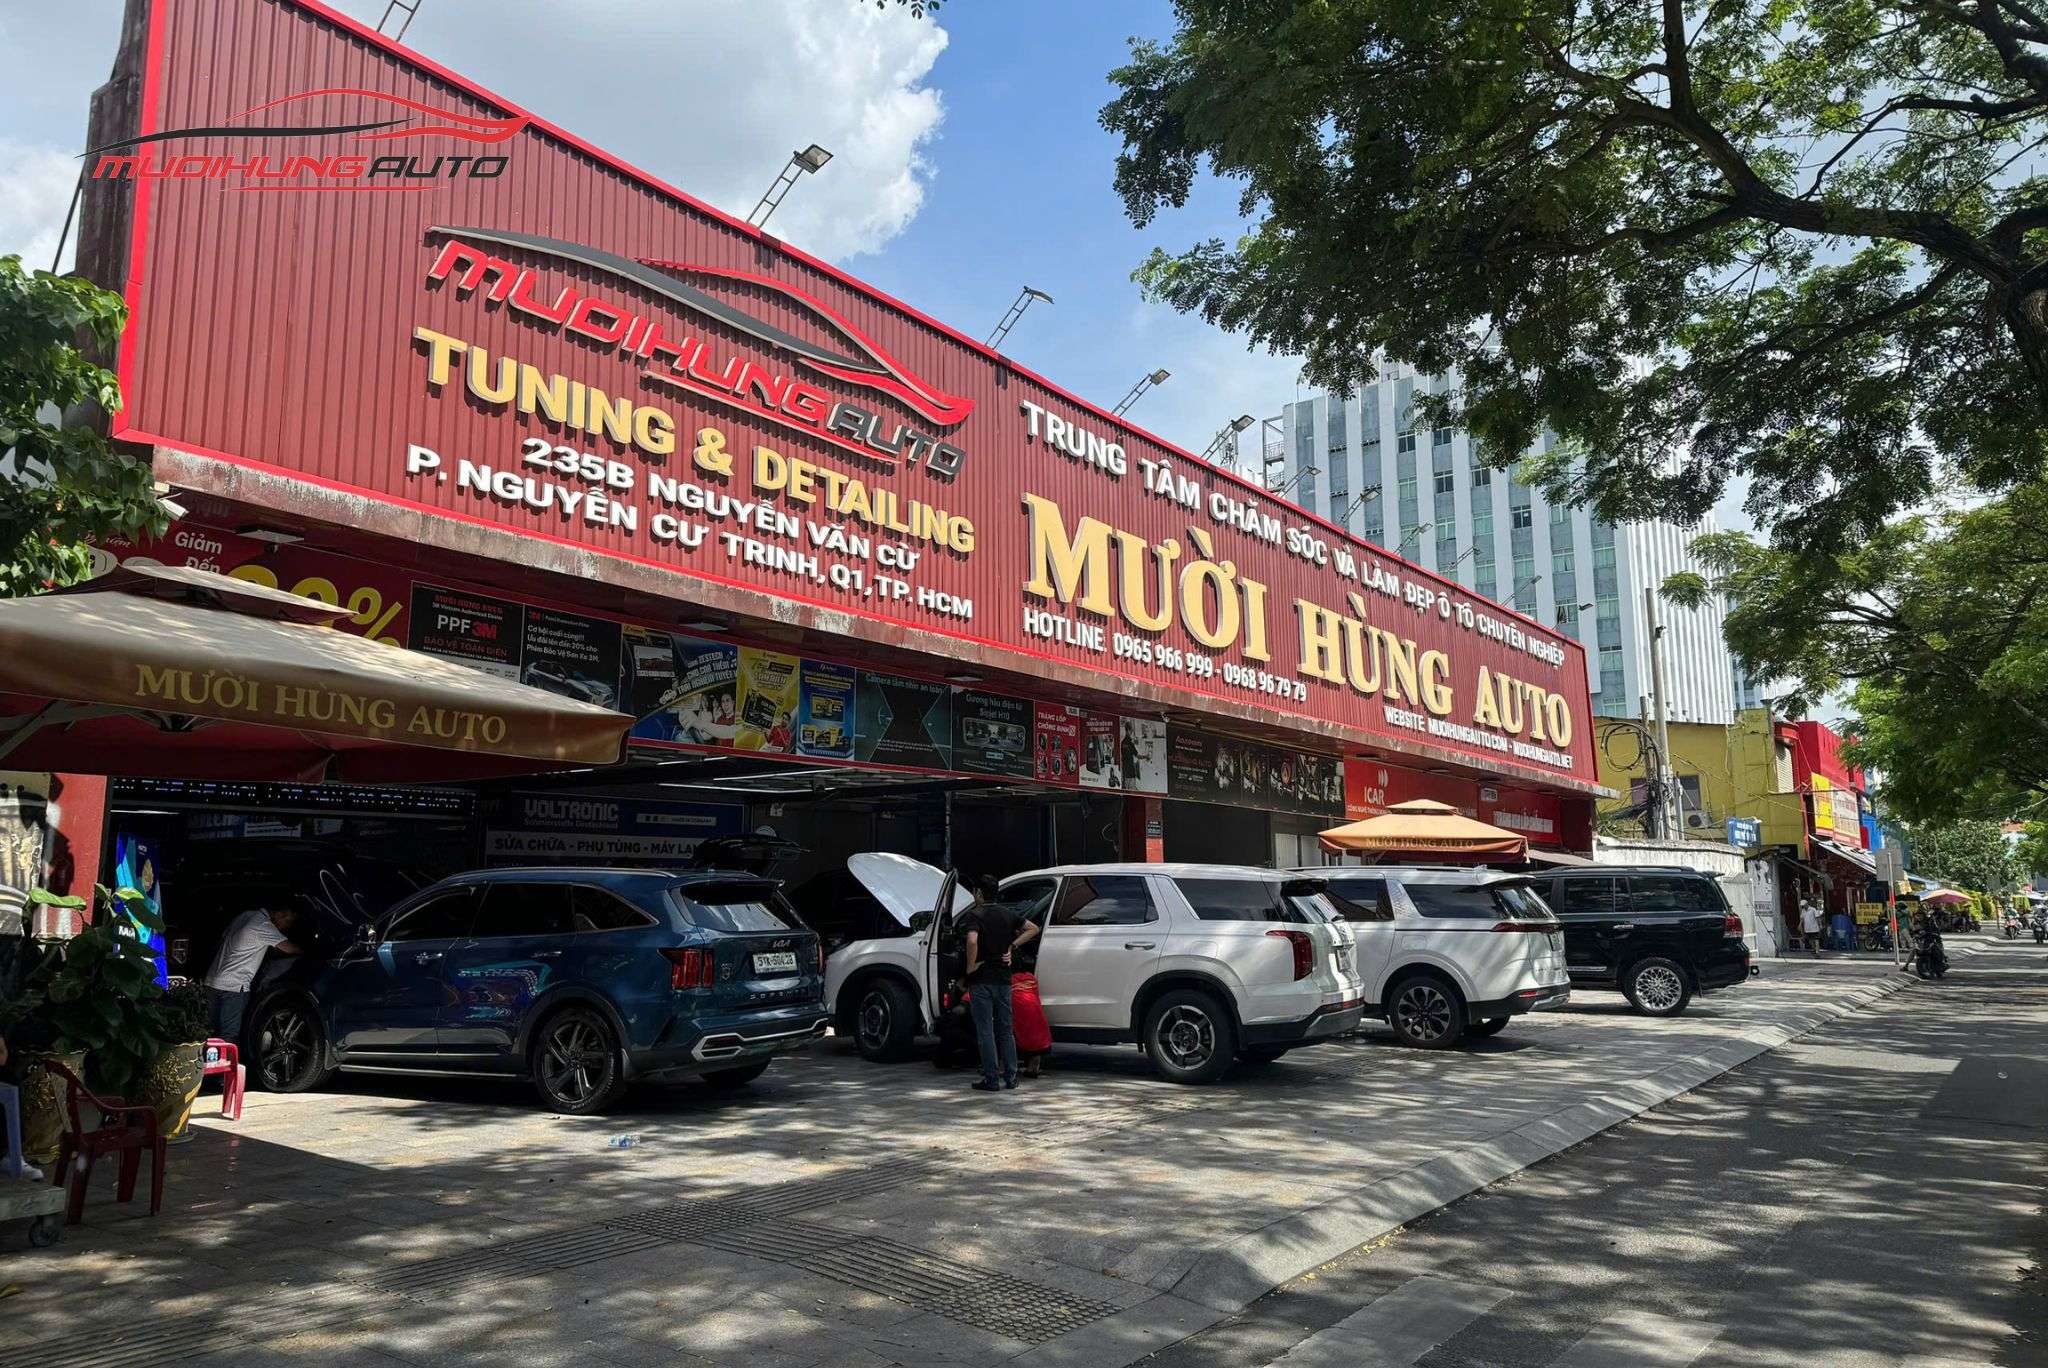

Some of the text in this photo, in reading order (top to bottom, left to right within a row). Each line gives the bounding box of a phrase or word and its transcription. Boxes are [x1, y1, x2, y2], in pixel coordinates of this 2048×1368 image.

[414, 327, 976, 553] TUNING & DETAILING
[407, 443, 447, 481] P.
[457, 459, 637, 531] NGUYỄN
[651, 513, 710, 547] CƯ
[917, 585, 974, 618] HCM
[523, 438, 920, 571] 235B NGUYỄN VĂN CỪ
[175, 531, 223, 555] Giảm
[1022, 400, 1565, 669] TRUNG TÂM CHĂM SÓC VÀ LÀM ĐẸP Ô TÔ CHUYÊN NGHIỆP
[437, 614, 497, 641] PPF 3M
[1021, 491, 1572, 748] MƯỜI HÙNG AUTO
[1113, 632, 1152, 663] 0965
[1155, 644, 1182, 672] 966
[1186, 652, 1213, 678] 999
[1223, 662, 1256, 689] 0968
[135, 664, 507, 744] MƯỜI HÙNG AUTO
[524, 799, 619, 822] VOLTRONIC
[1364, 785, 1385, 806] ICAR
[494, 833, 524, 851] SỬA
[528, 835, 566, 851] CHỮA
[577, 840, 604, 855] PHỤ
[651, 840, 676, 855] MÁY
[1440, 837, 1474, 849] AUTO
